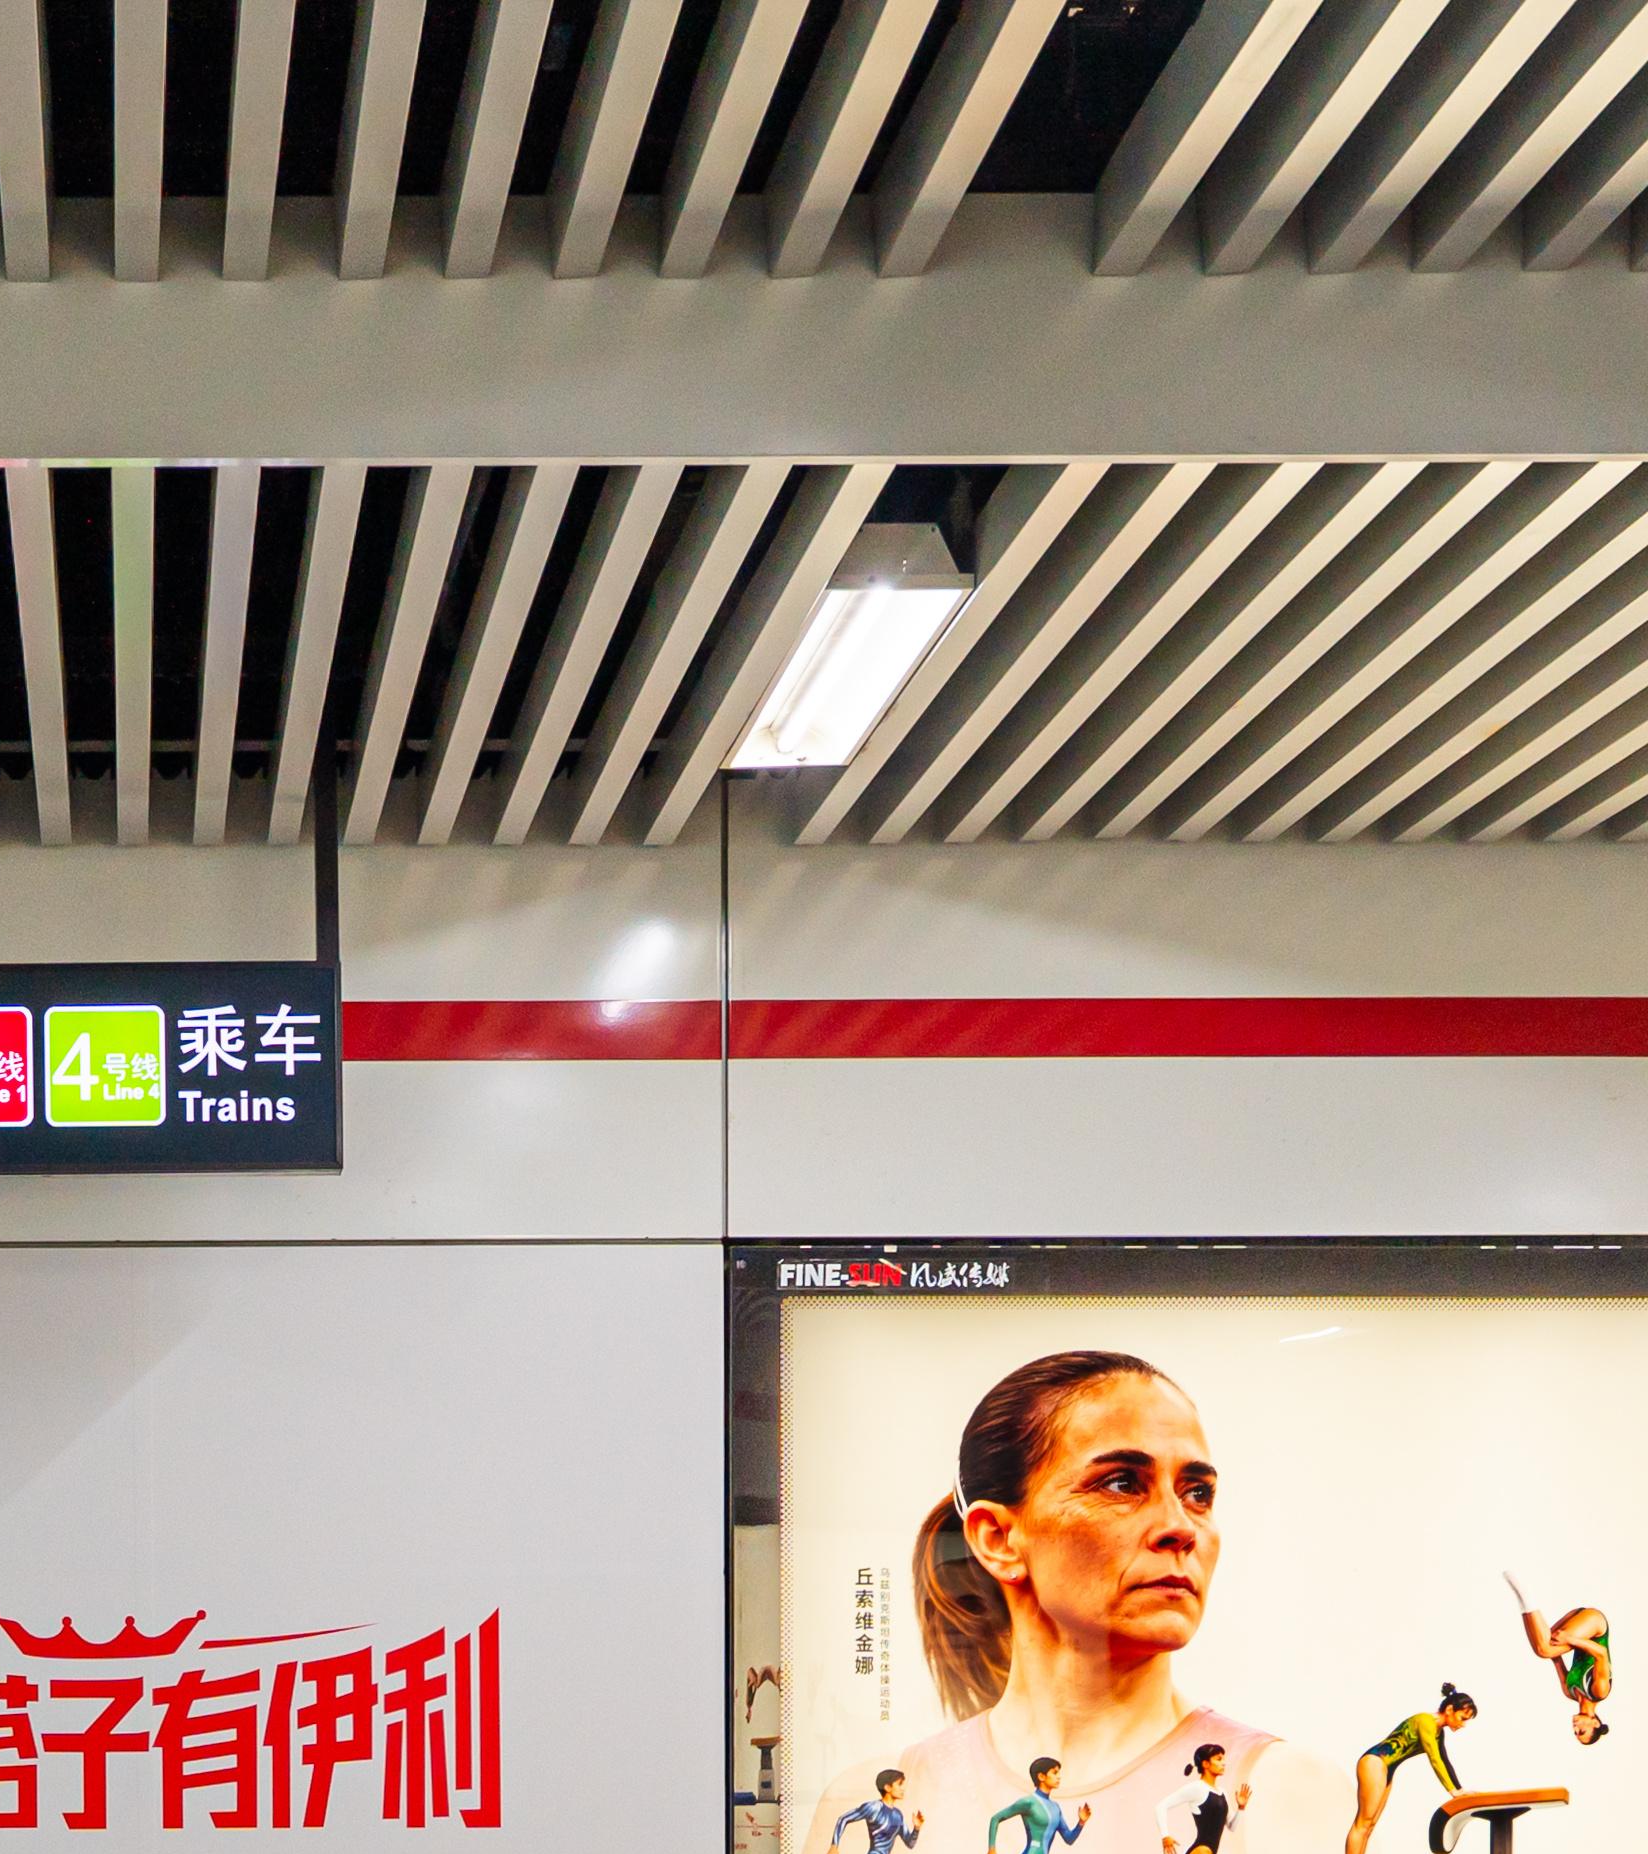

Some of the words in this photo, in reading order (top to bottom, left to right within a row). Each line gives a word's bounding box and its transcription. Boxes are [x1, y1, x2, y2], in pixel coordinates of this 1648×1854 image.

[178, 1004, 322, 1077] 乘车
[16, 1085, 27, 1104] 1
[103, 1082, 145, 1101] Line
[148, 1083, 161, 1100] 4
[178, 1090, 297, 1123] Trains
[854, 1567, 875, 1675] 丘索维金娜
